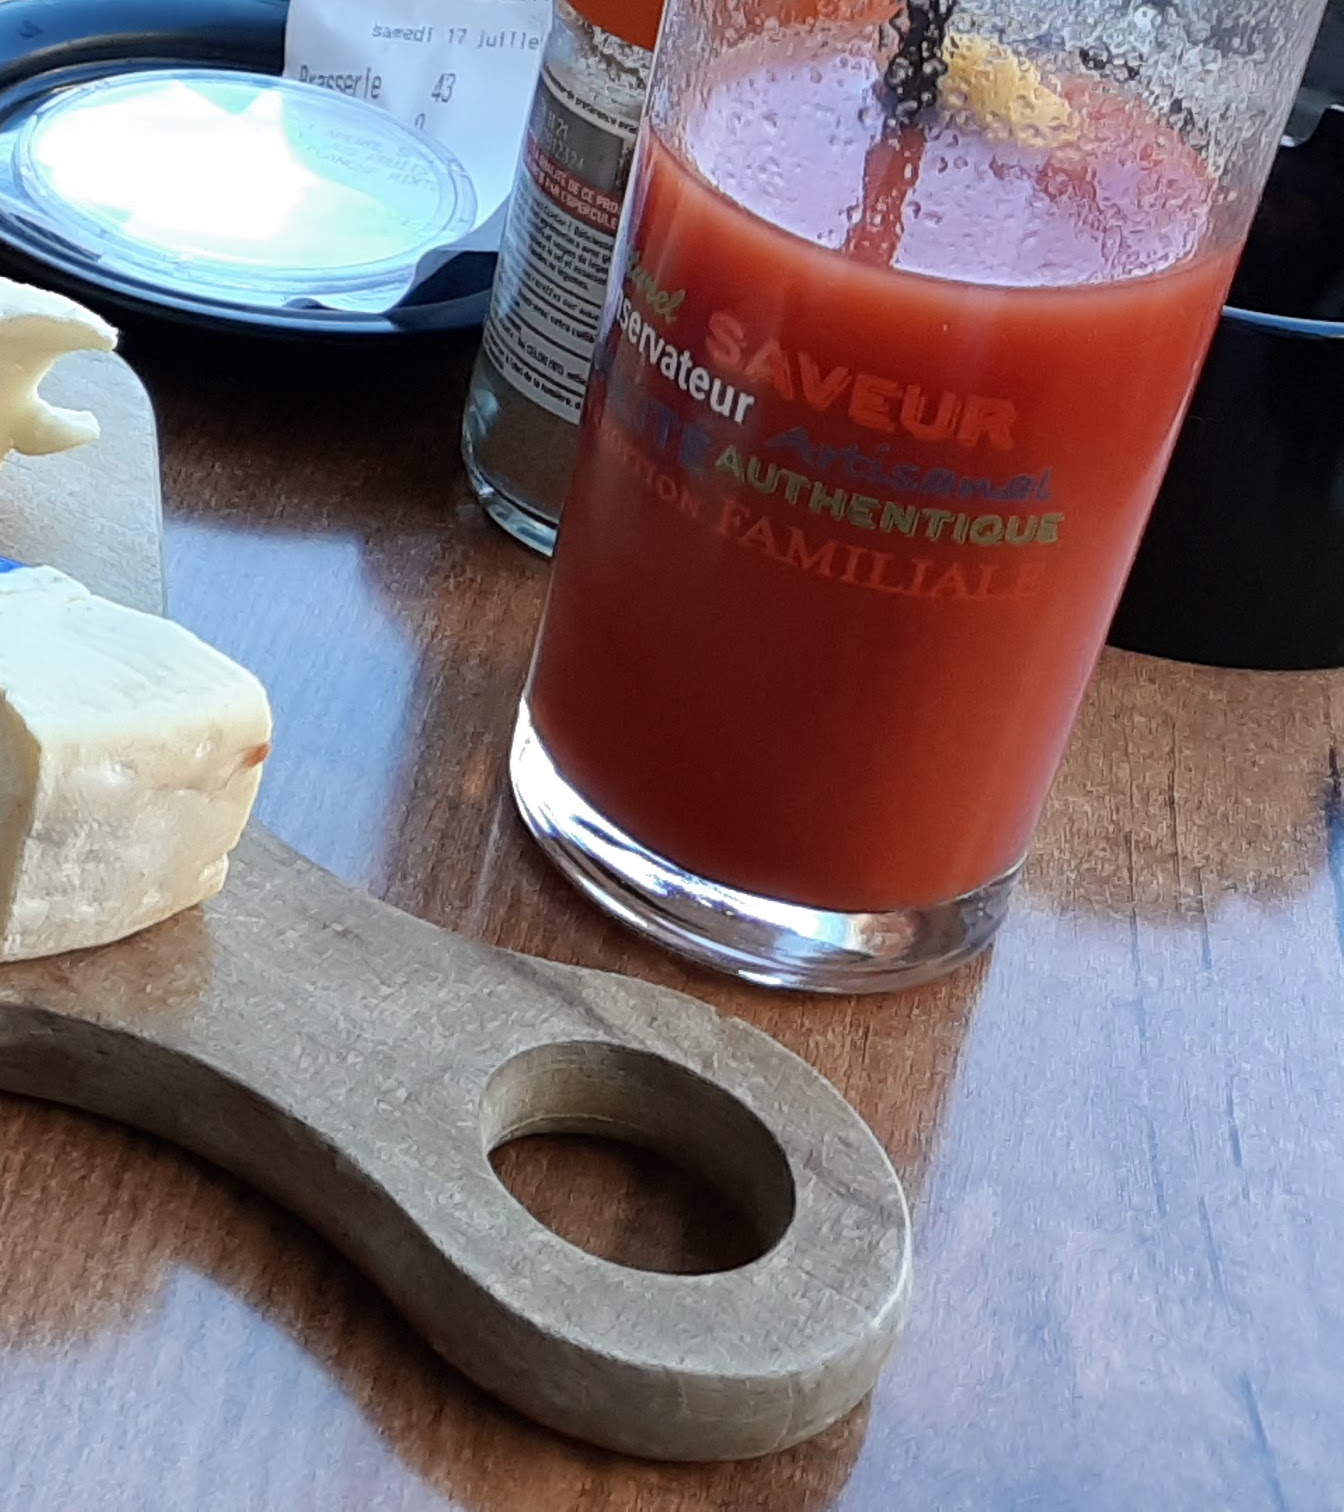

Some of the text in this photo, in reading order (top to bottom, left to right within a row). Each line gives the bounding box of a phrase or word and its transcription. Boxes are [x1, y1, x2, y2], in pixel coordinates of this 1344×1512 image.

[372, 23, 544, 50] samedi 17 juille
[431, 73, 457, 103] 43
[705, 310, 1018, 450] SAVEUR
[714, 444, 1065, 546] AUTHENTIQUE
[714, 496, 1049, 600] FAMILIALE
